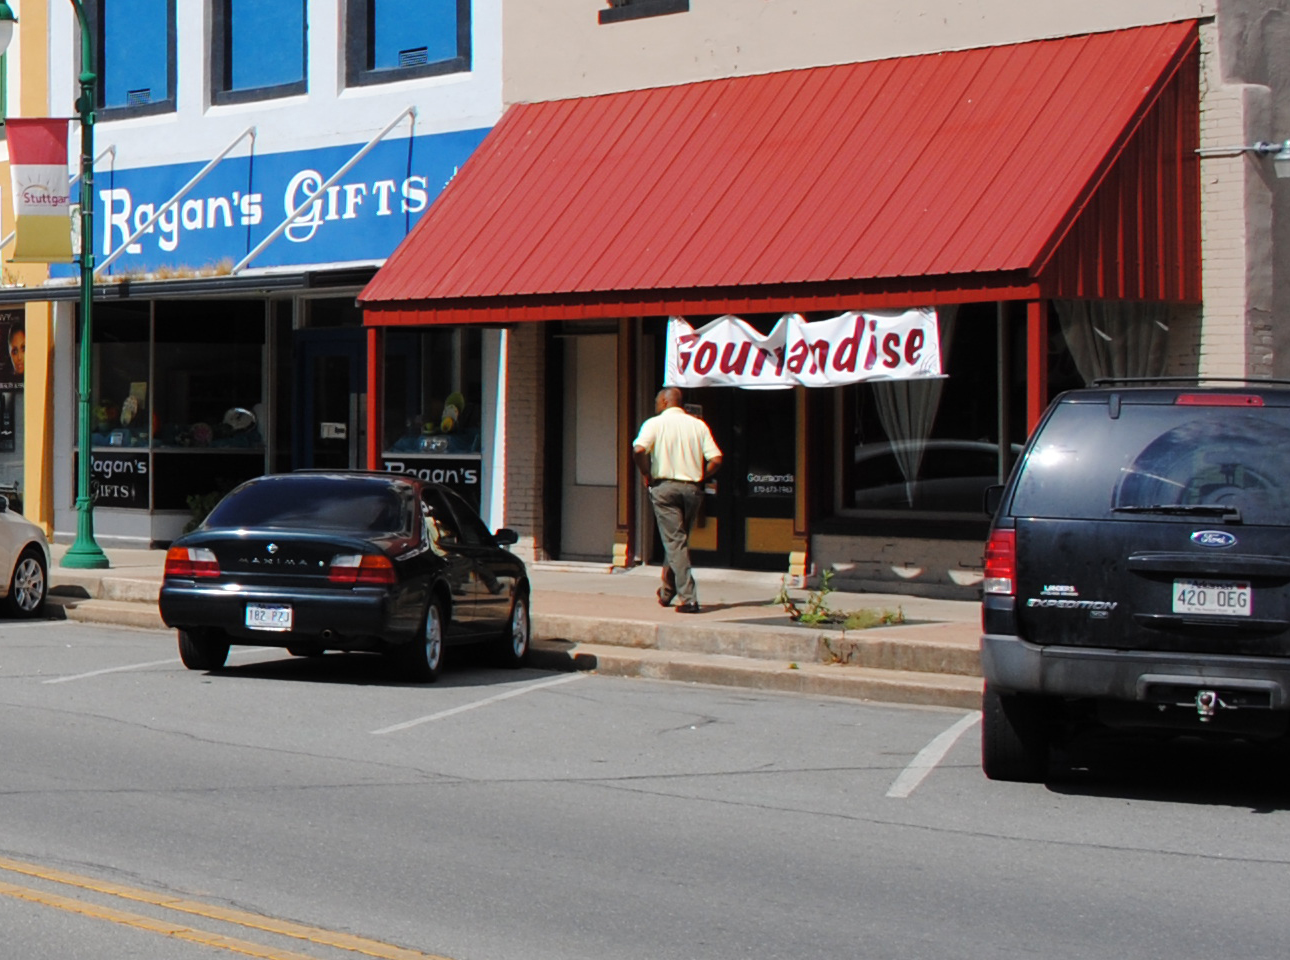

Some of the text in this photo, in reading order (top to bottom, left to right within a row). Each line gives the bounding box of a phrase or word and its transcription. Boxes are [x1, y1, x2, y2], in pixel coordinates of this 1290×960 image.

[23, 192, 69, 207] Stuttgar
[99, 188, 262, 255] Ragan's
[91, 456, 147, 478] agan's
[747, 473, 794, 483] Gourmandis
[239, 557, 308, 566] MAXIMA
[1027, 598, 1118, 611] EXPEDITION
[1177, 589, 1207, 607] 420
[249, 610, 266, 622] 182
